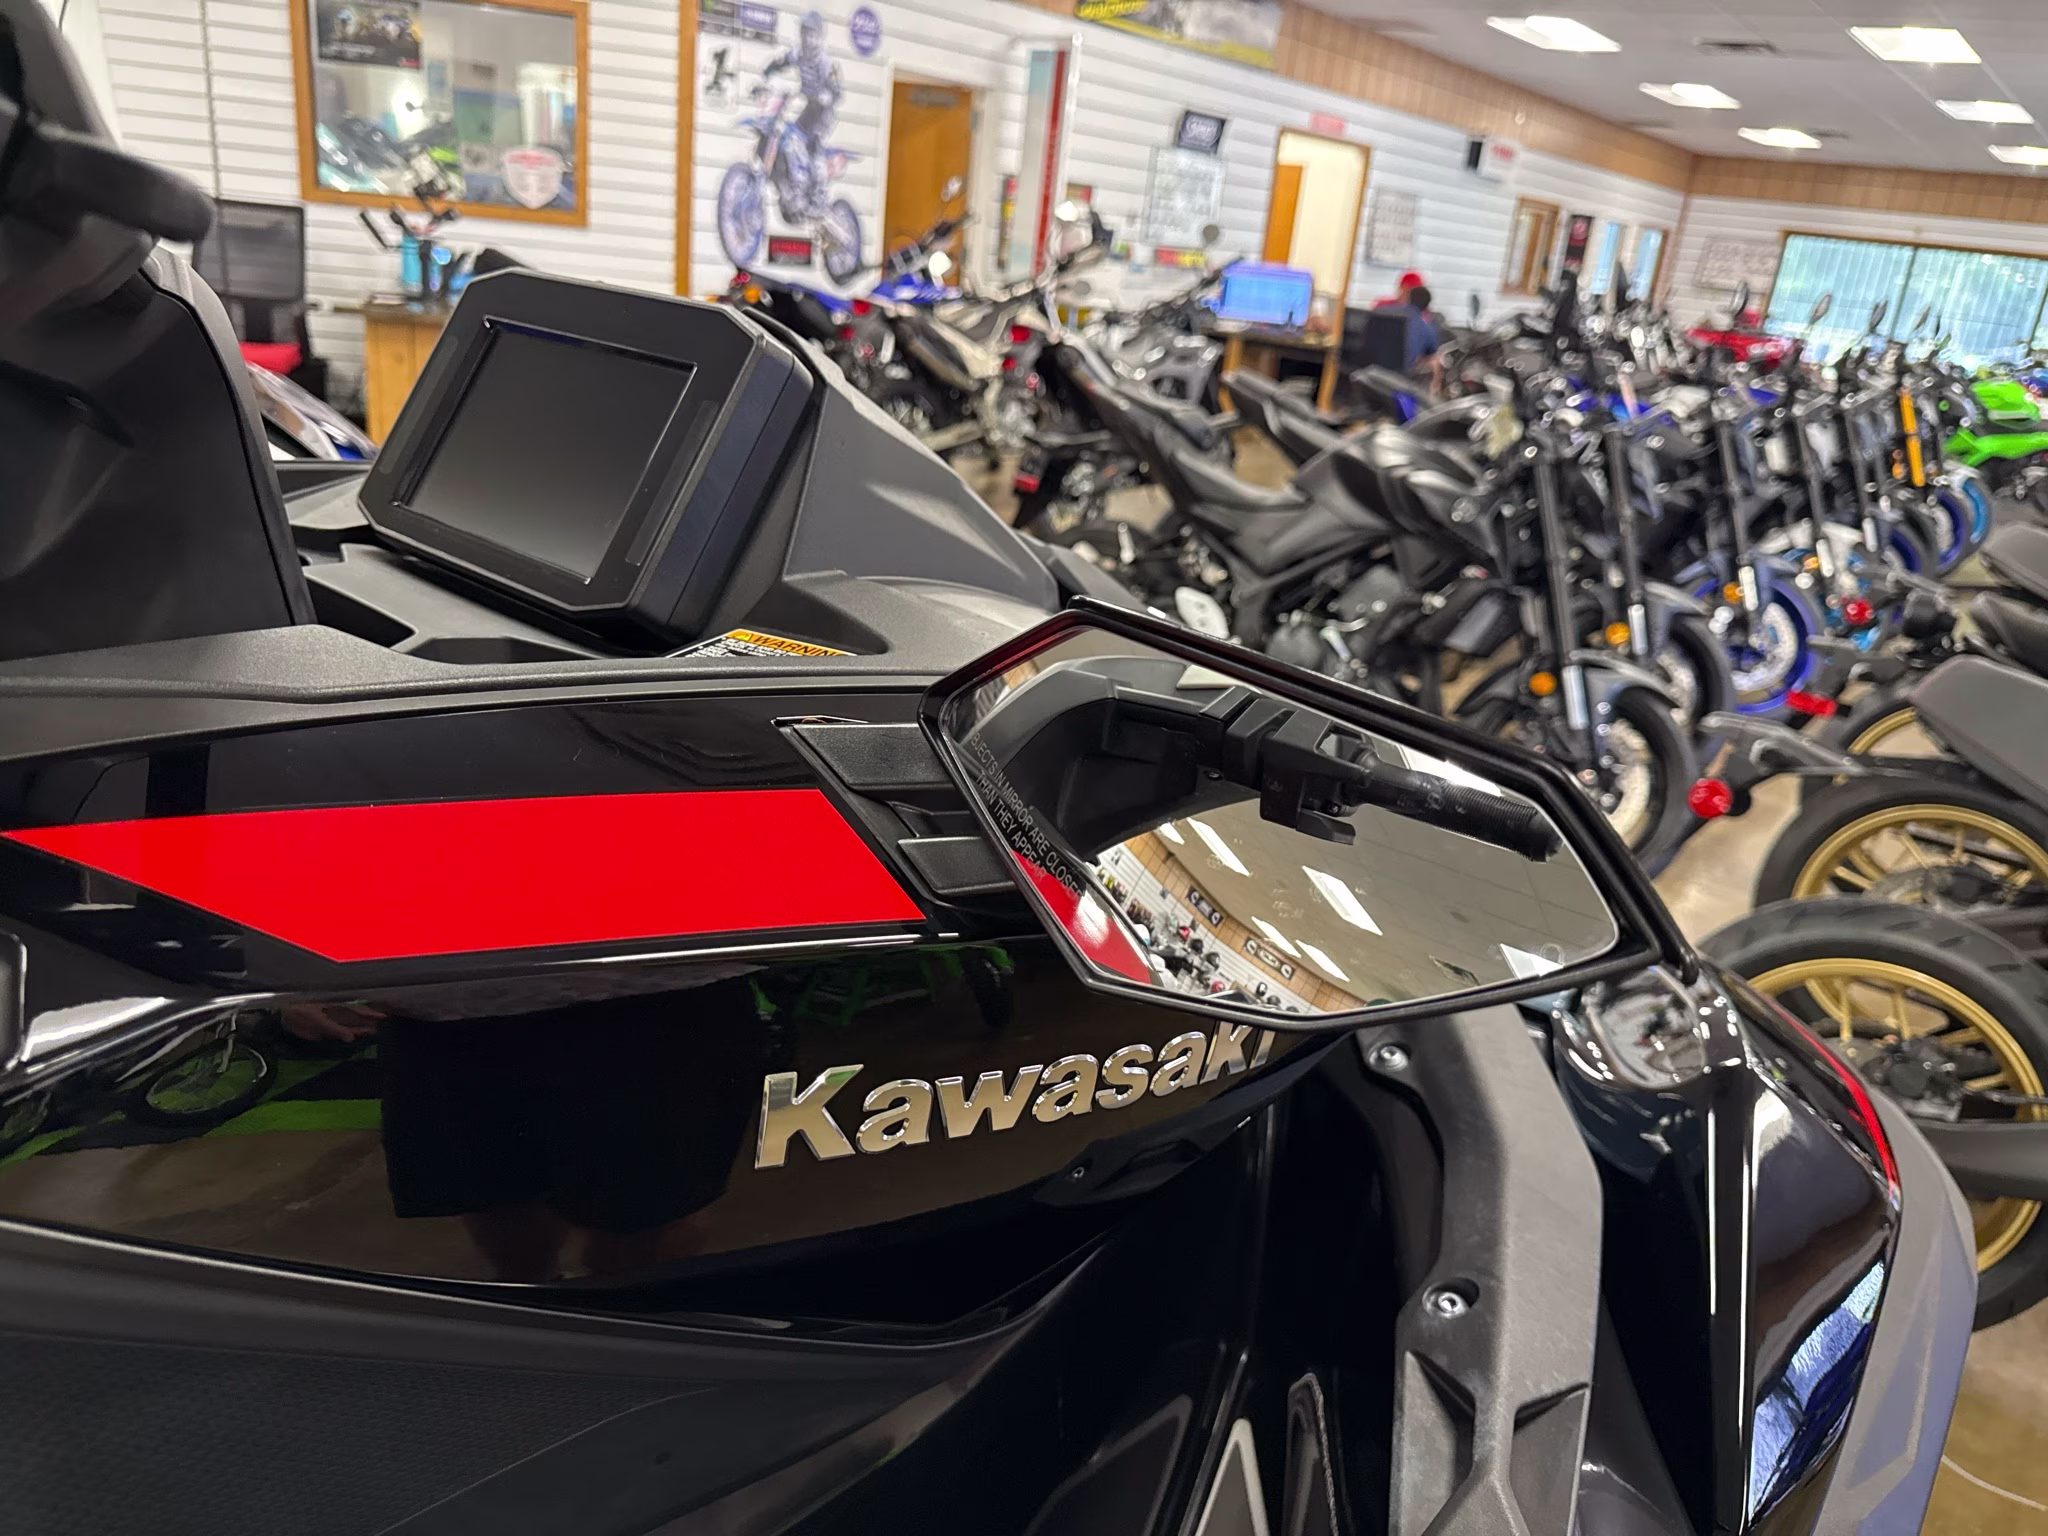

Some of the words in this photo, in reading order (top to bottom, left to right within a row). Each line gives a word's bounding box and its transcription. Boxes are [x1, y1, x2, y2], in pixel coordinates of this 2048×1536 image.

[754, 635, 848, 656] WARNIN
[969, 731, 998, 774] BJECTS
[994, 770, 1005, 788] IN
[1001, 780, 1034, 829] MIRROR
[1028, 827, 1050, 856] ARE
[975, 770, 998, 806] THAN
[994, 798, 1017, 833] THEY
[1011, 831, 1048, 882] APPEAR
